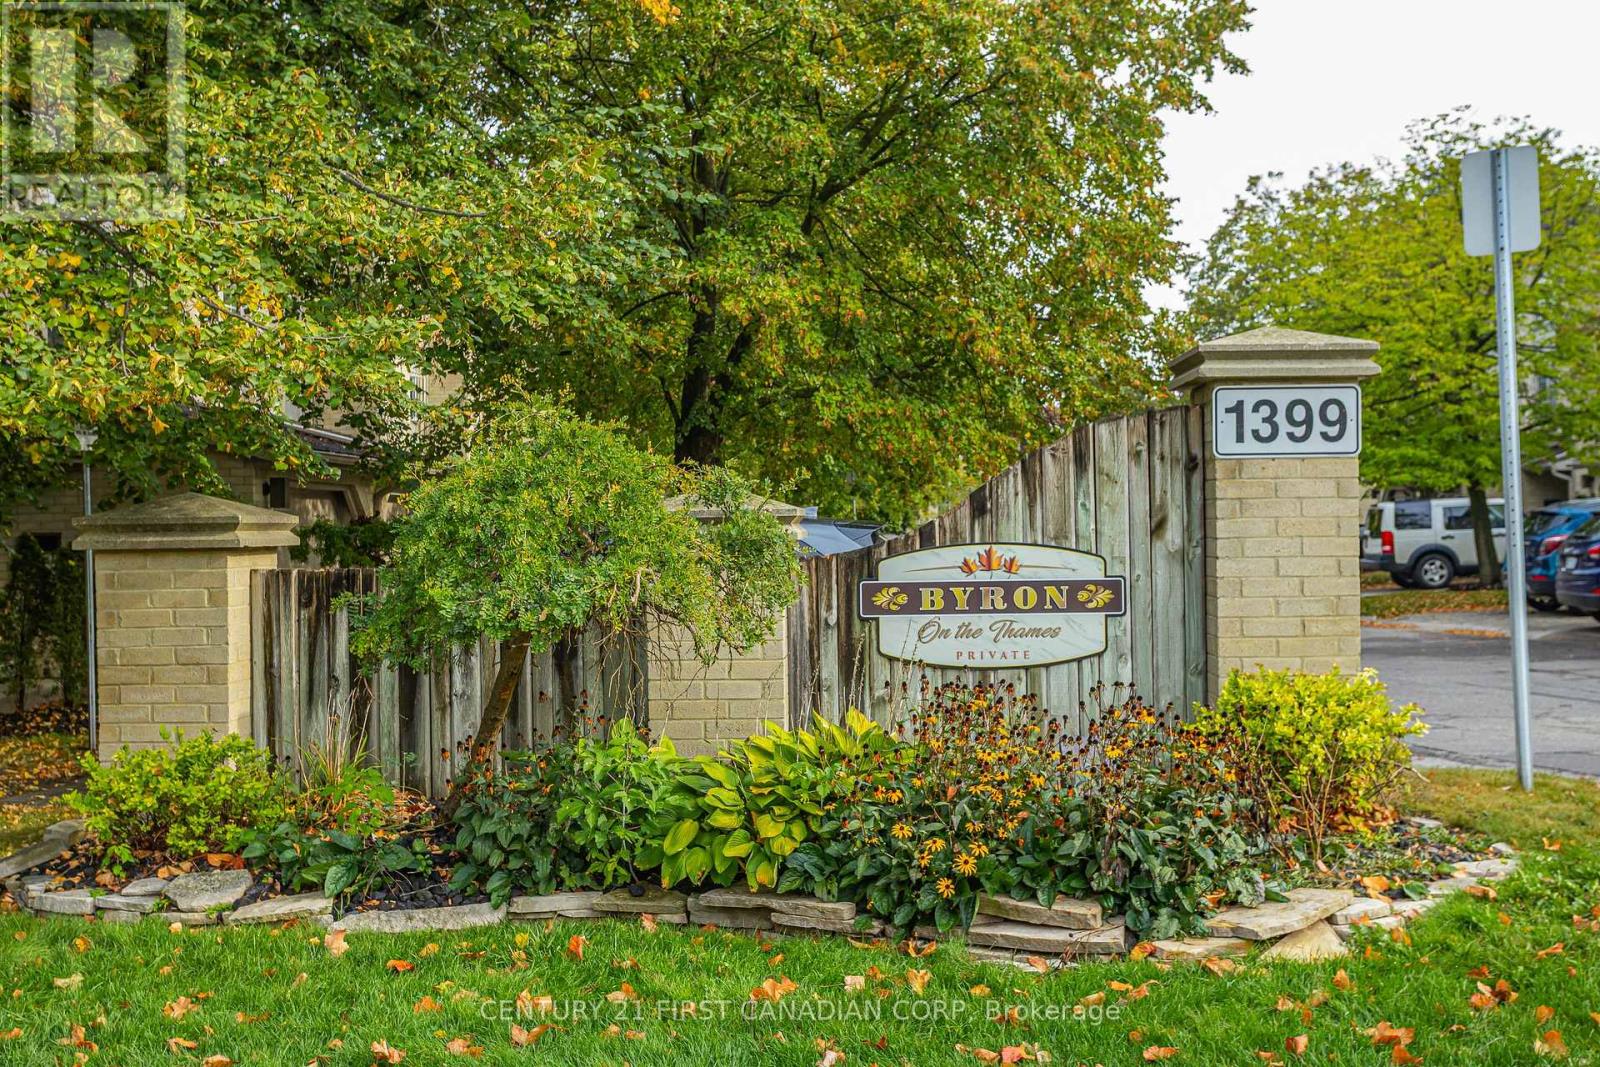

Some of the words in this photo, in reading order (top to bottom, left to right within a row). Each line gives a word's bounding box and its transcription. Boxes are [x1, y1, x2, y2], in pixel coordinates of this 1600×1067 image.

[1224, 398, 1348, 444] 1399
[919, 585, 1069, 611] BYRON
[917, 616, 952, 644] On
[955, 621, 983, 639] the
[989, 618, 1062, 643] Thames
[956, 650, 1031, 661] PRIVATE
